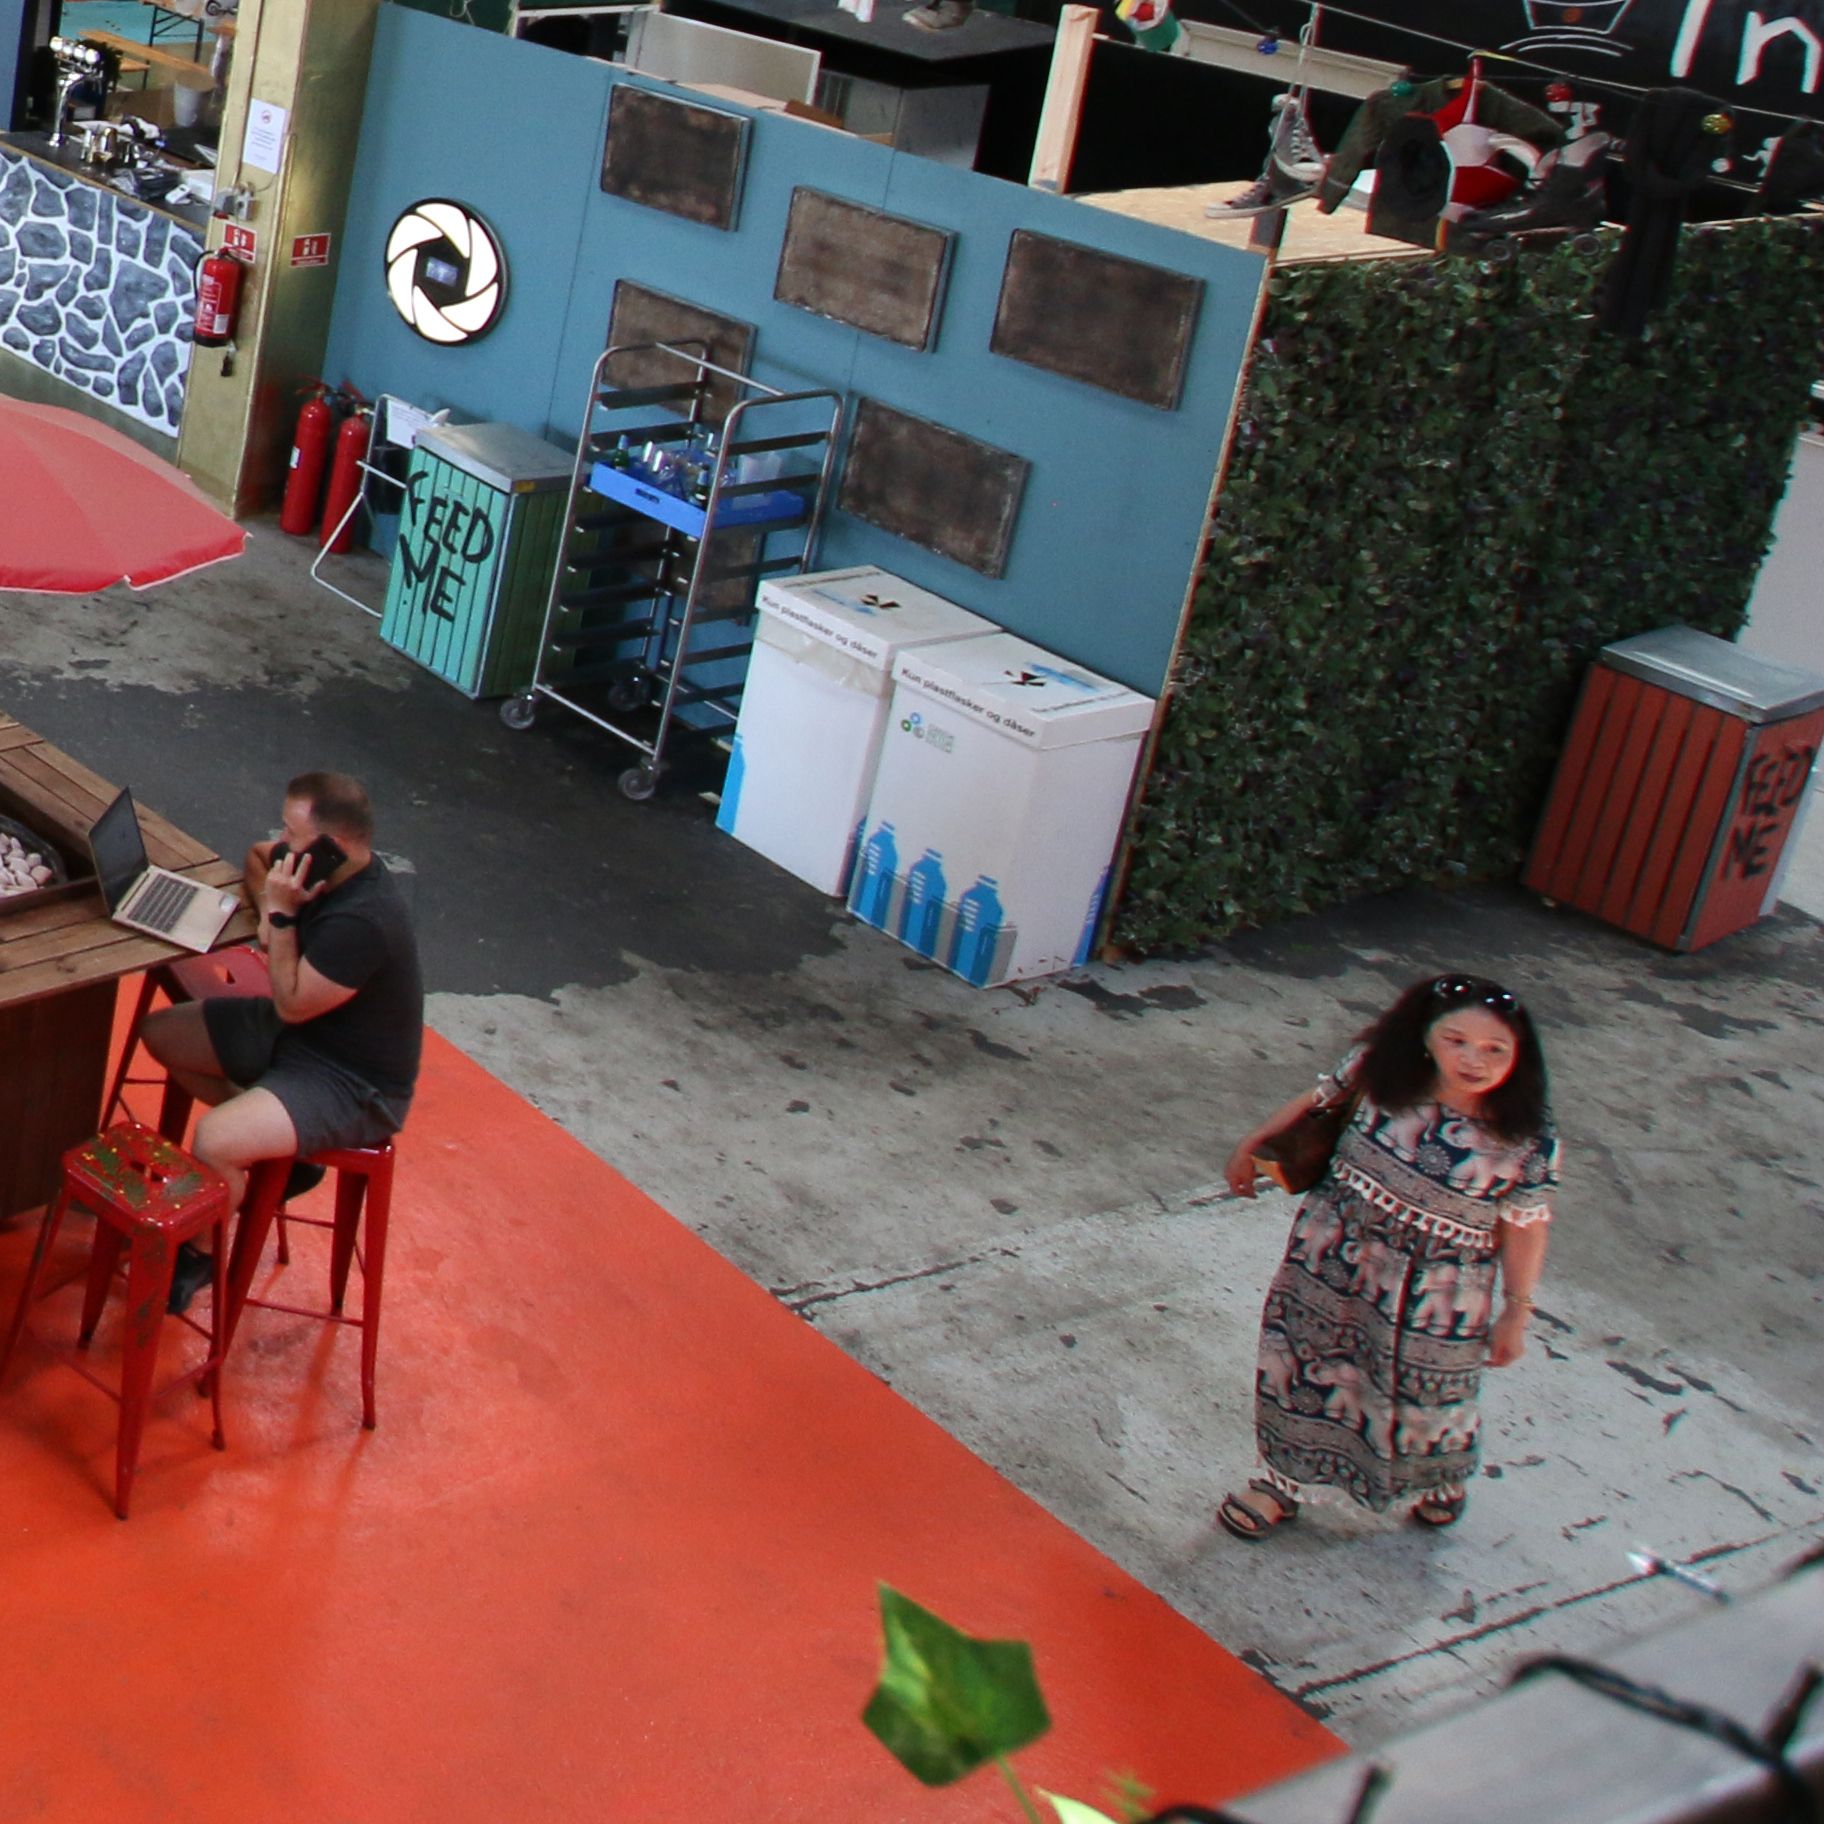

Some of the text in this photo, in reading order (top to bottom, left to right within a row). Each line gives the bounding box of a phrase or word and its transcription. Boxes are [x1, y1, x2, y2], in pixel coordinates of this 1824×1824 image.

[406, 470, 494, 563] FEED
[399, 533, 466, 623] ME
[762, 594, 878, 659] Kun plastflasker og dåser
[901, 667, 1035, 738] Kun plastflasker og dåser
